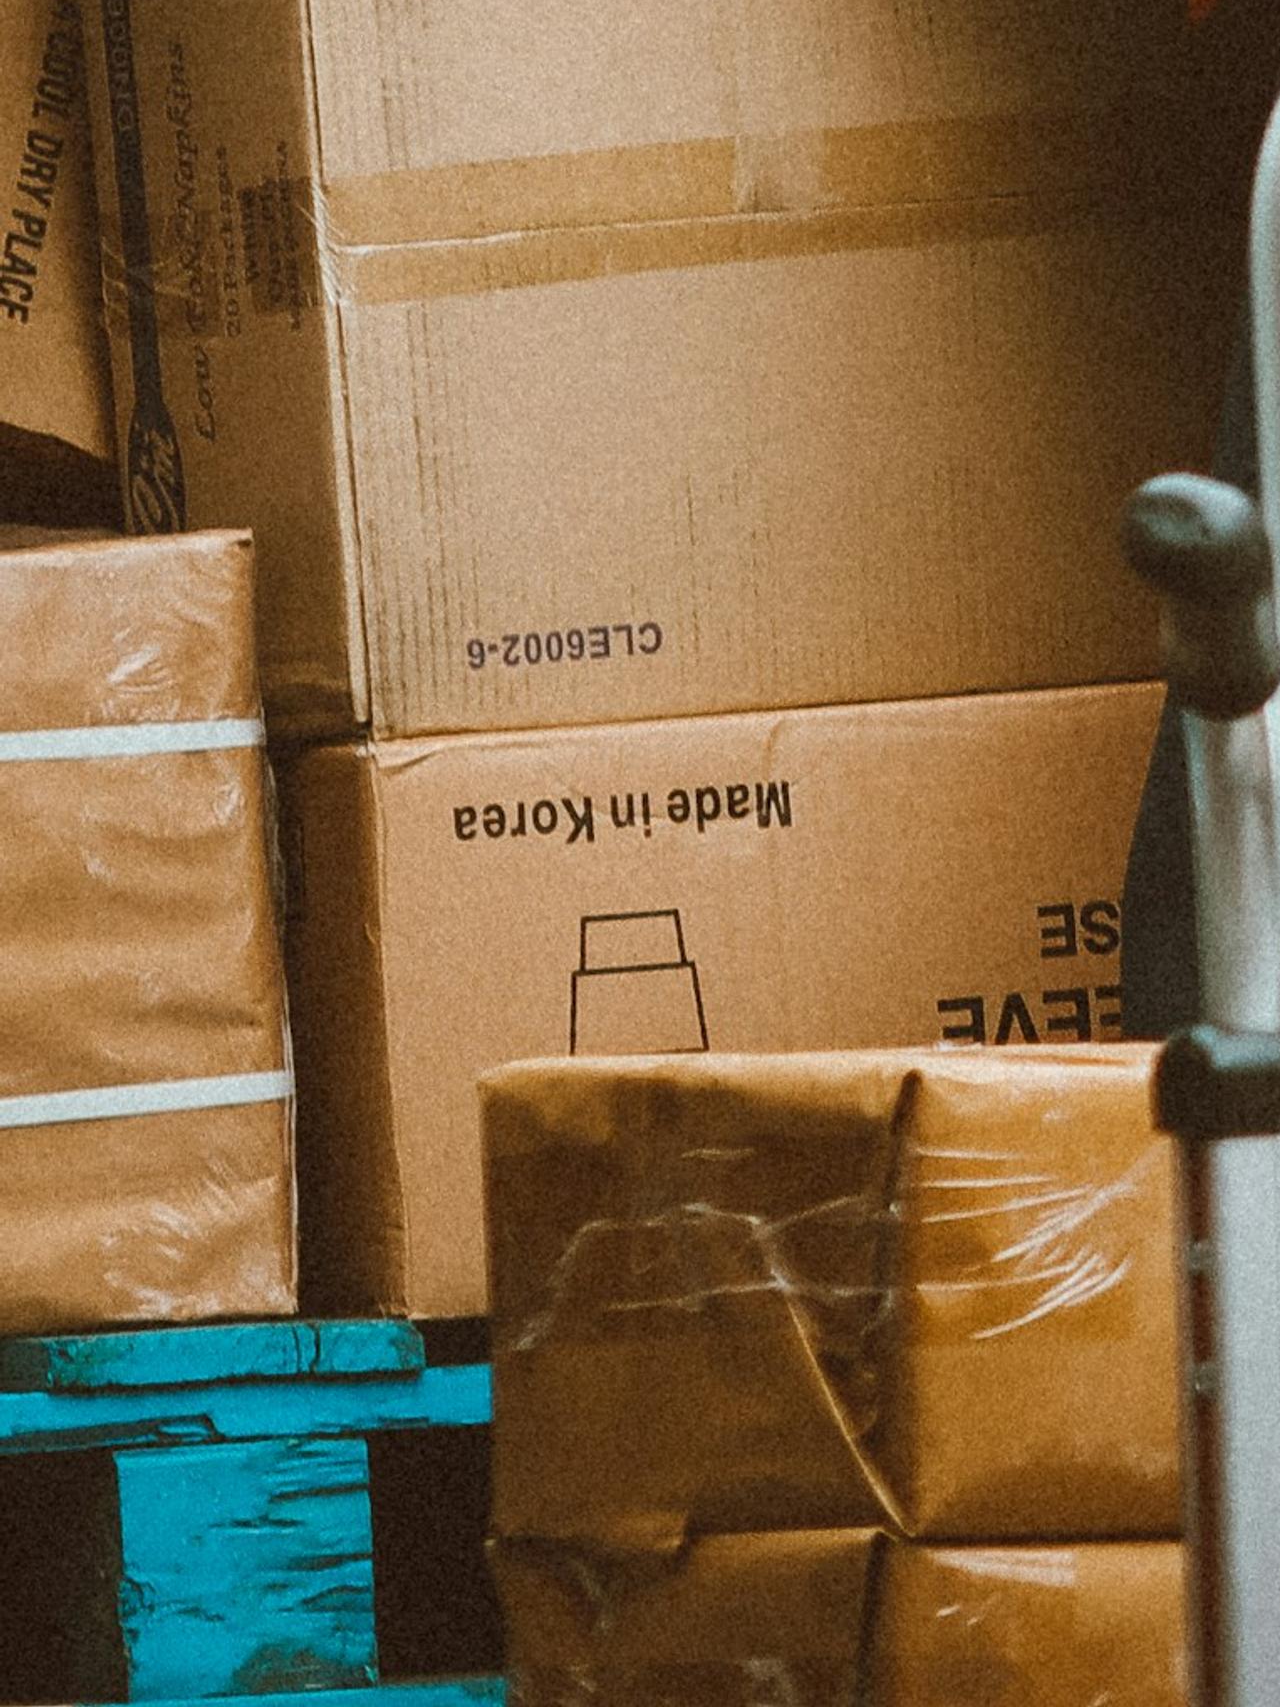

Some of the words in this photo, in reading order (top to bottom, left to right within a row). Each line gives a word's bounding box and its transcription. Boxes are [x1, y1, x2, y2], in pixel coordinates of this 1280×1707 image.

[17, 131, 64, 209] DRY
[466, 622, 663, 671] CLE6002-6
[453, 796, 594, 844] Korea
[610, 792, 652, 838] in
[667, 781, 792, 834] Made
